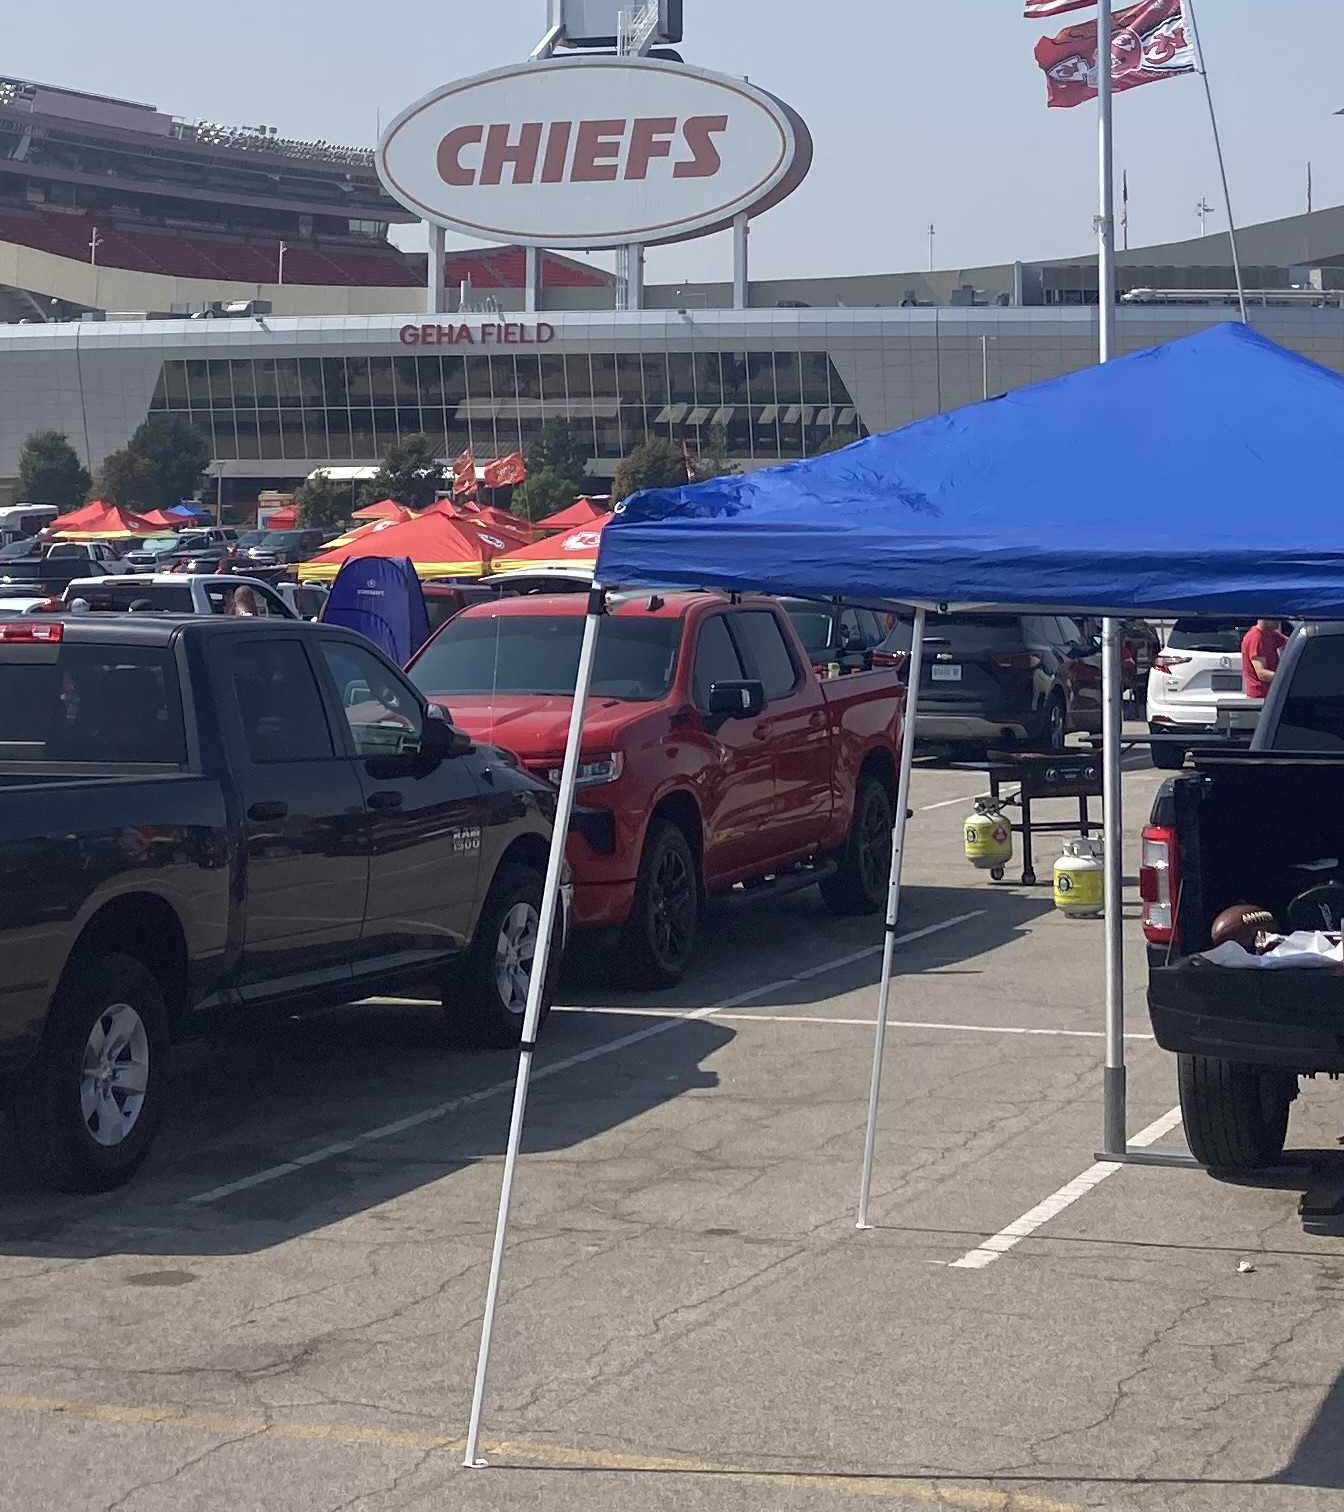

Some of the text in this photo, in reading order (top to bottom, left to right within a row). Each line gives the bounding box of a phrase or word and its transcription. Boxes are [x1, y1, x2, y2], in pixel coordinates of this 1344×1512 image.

[436, 114, 729, 186] CHIEFS
[399, 323, 555, 346] GEHA FIELD
